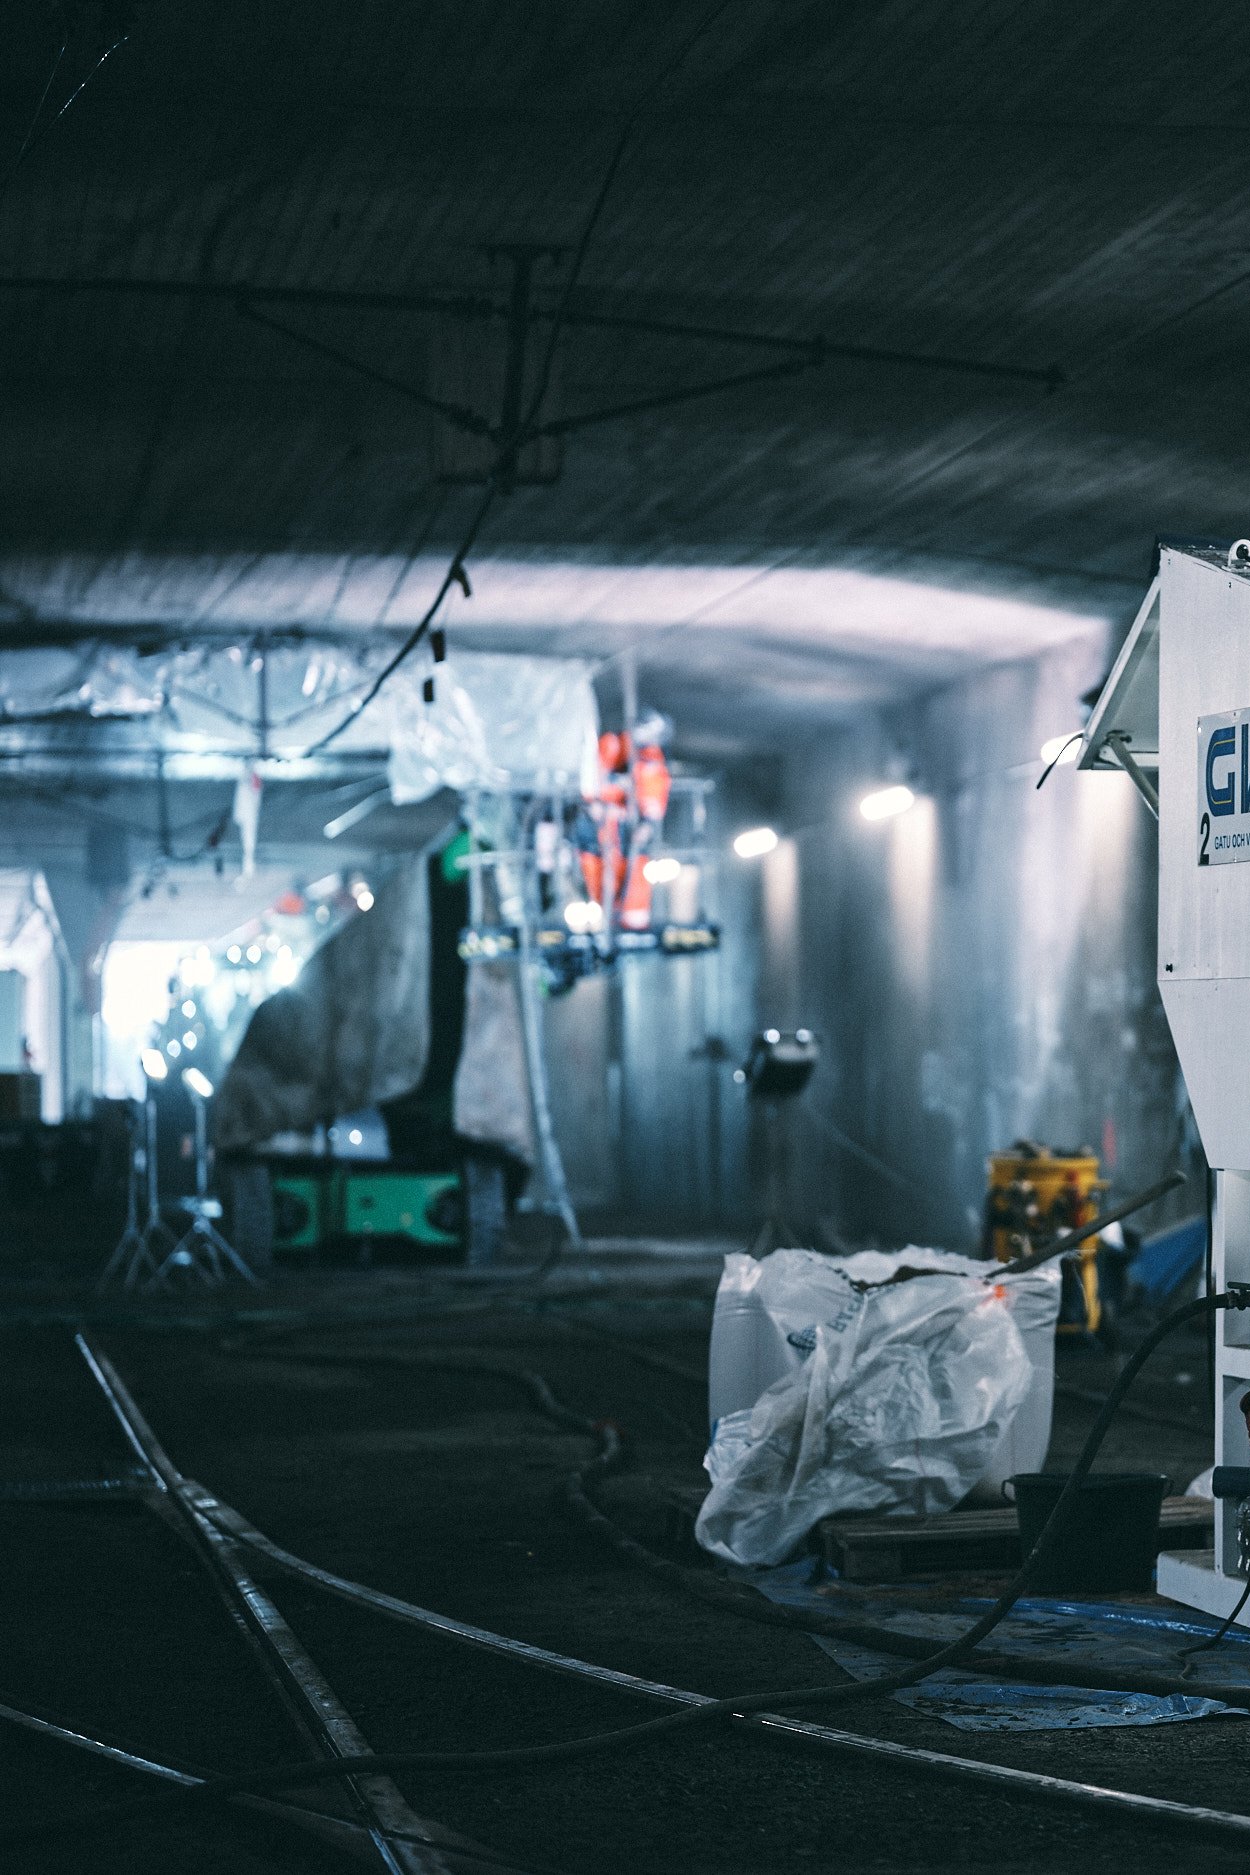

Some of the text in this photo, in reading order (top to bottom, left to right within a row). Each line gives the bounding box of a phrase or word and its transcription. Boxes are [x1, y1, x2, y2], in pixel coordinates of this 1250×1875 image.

[1200, 812, 1210, 865] 2
[1214, 835, 1231, 850] GATU
[1232, 833, 1245, 848] OCH
